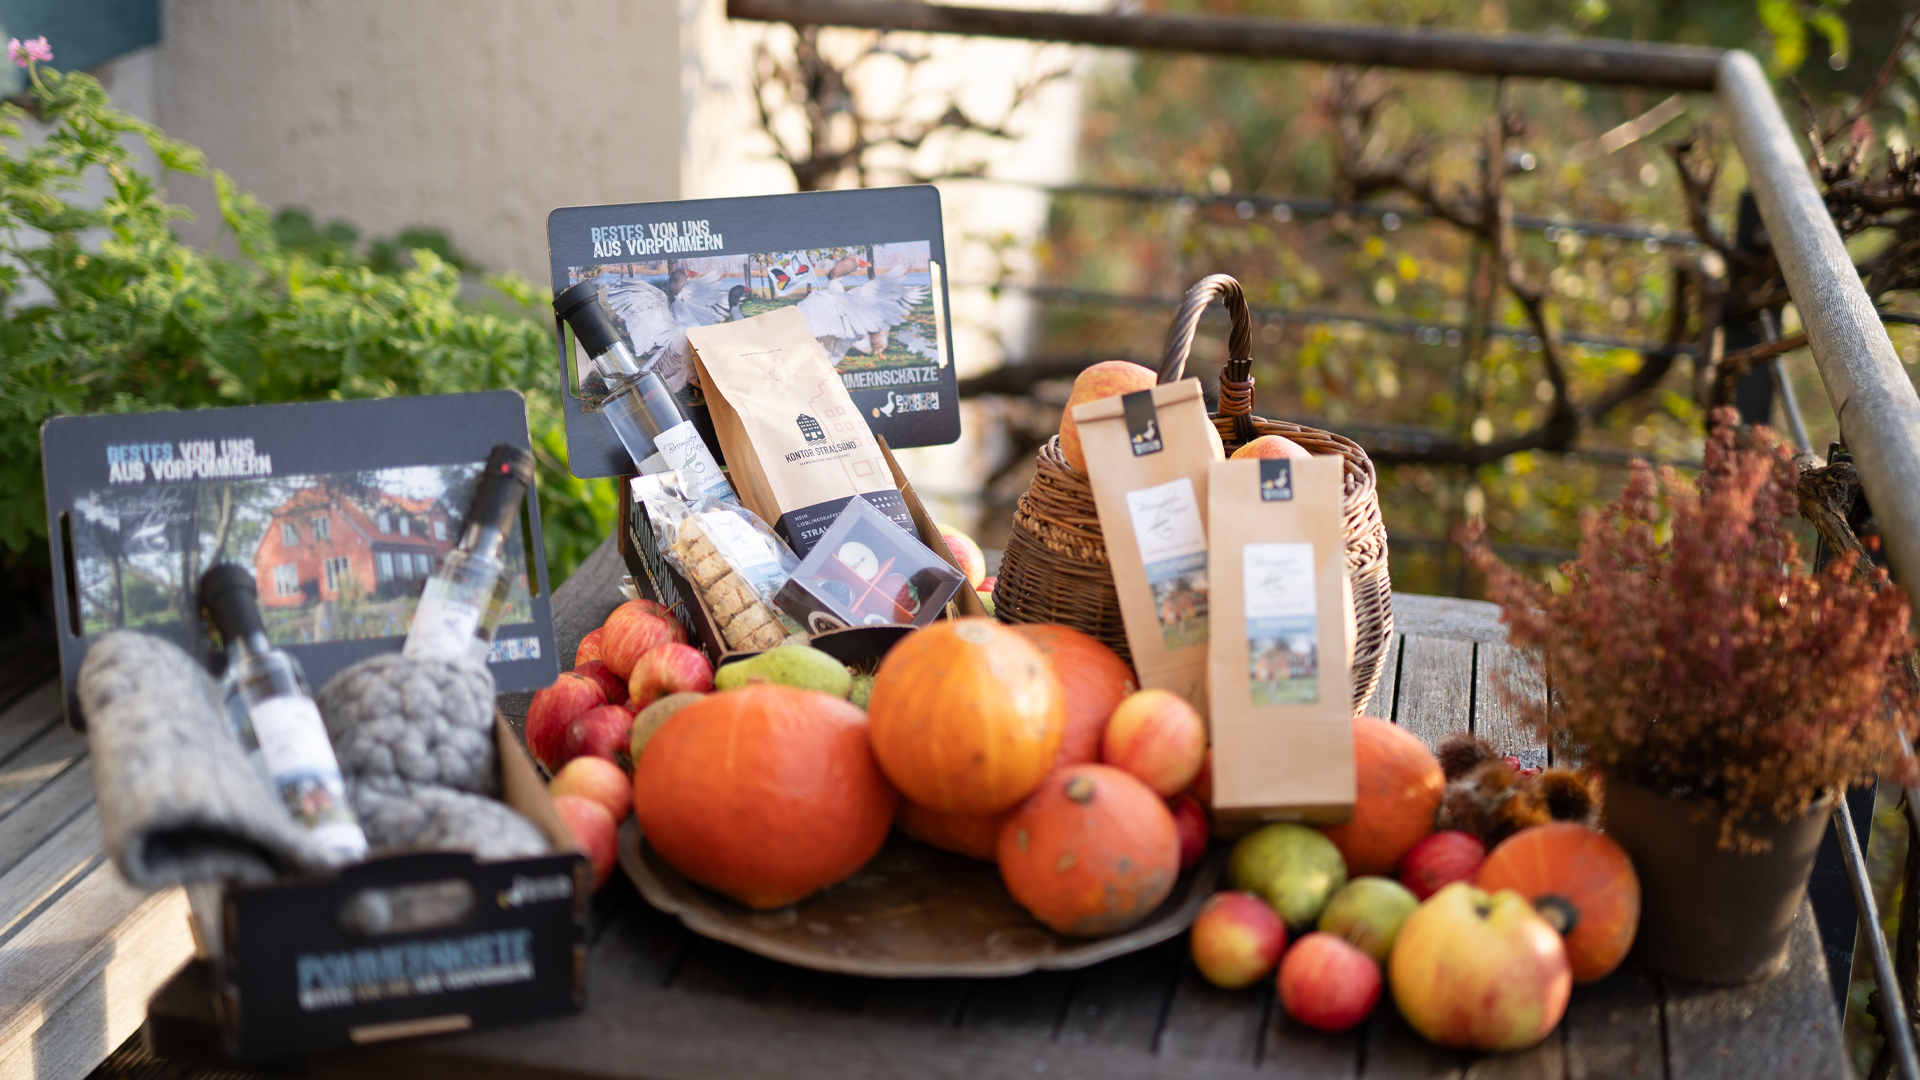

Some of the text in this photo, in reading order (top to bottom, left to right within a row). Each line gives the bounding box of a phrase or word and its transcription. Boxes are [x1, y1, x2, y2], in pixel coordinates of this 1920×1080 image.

[591, 219, 710, 243] BESTES VON UNS
[593, 234, 723, 258] AUS VORPOMMERN
[839, 366, 939, 389] MMERNSCHÄTZE
[895, 391, 939, 407] POMMERN
[106, 438, 256, 466] BESTES VON UNS
[784, 441, 857, 463] KONTOR STRALSUND
[108, 454, 273, 483] AUS VORPOMMERN
